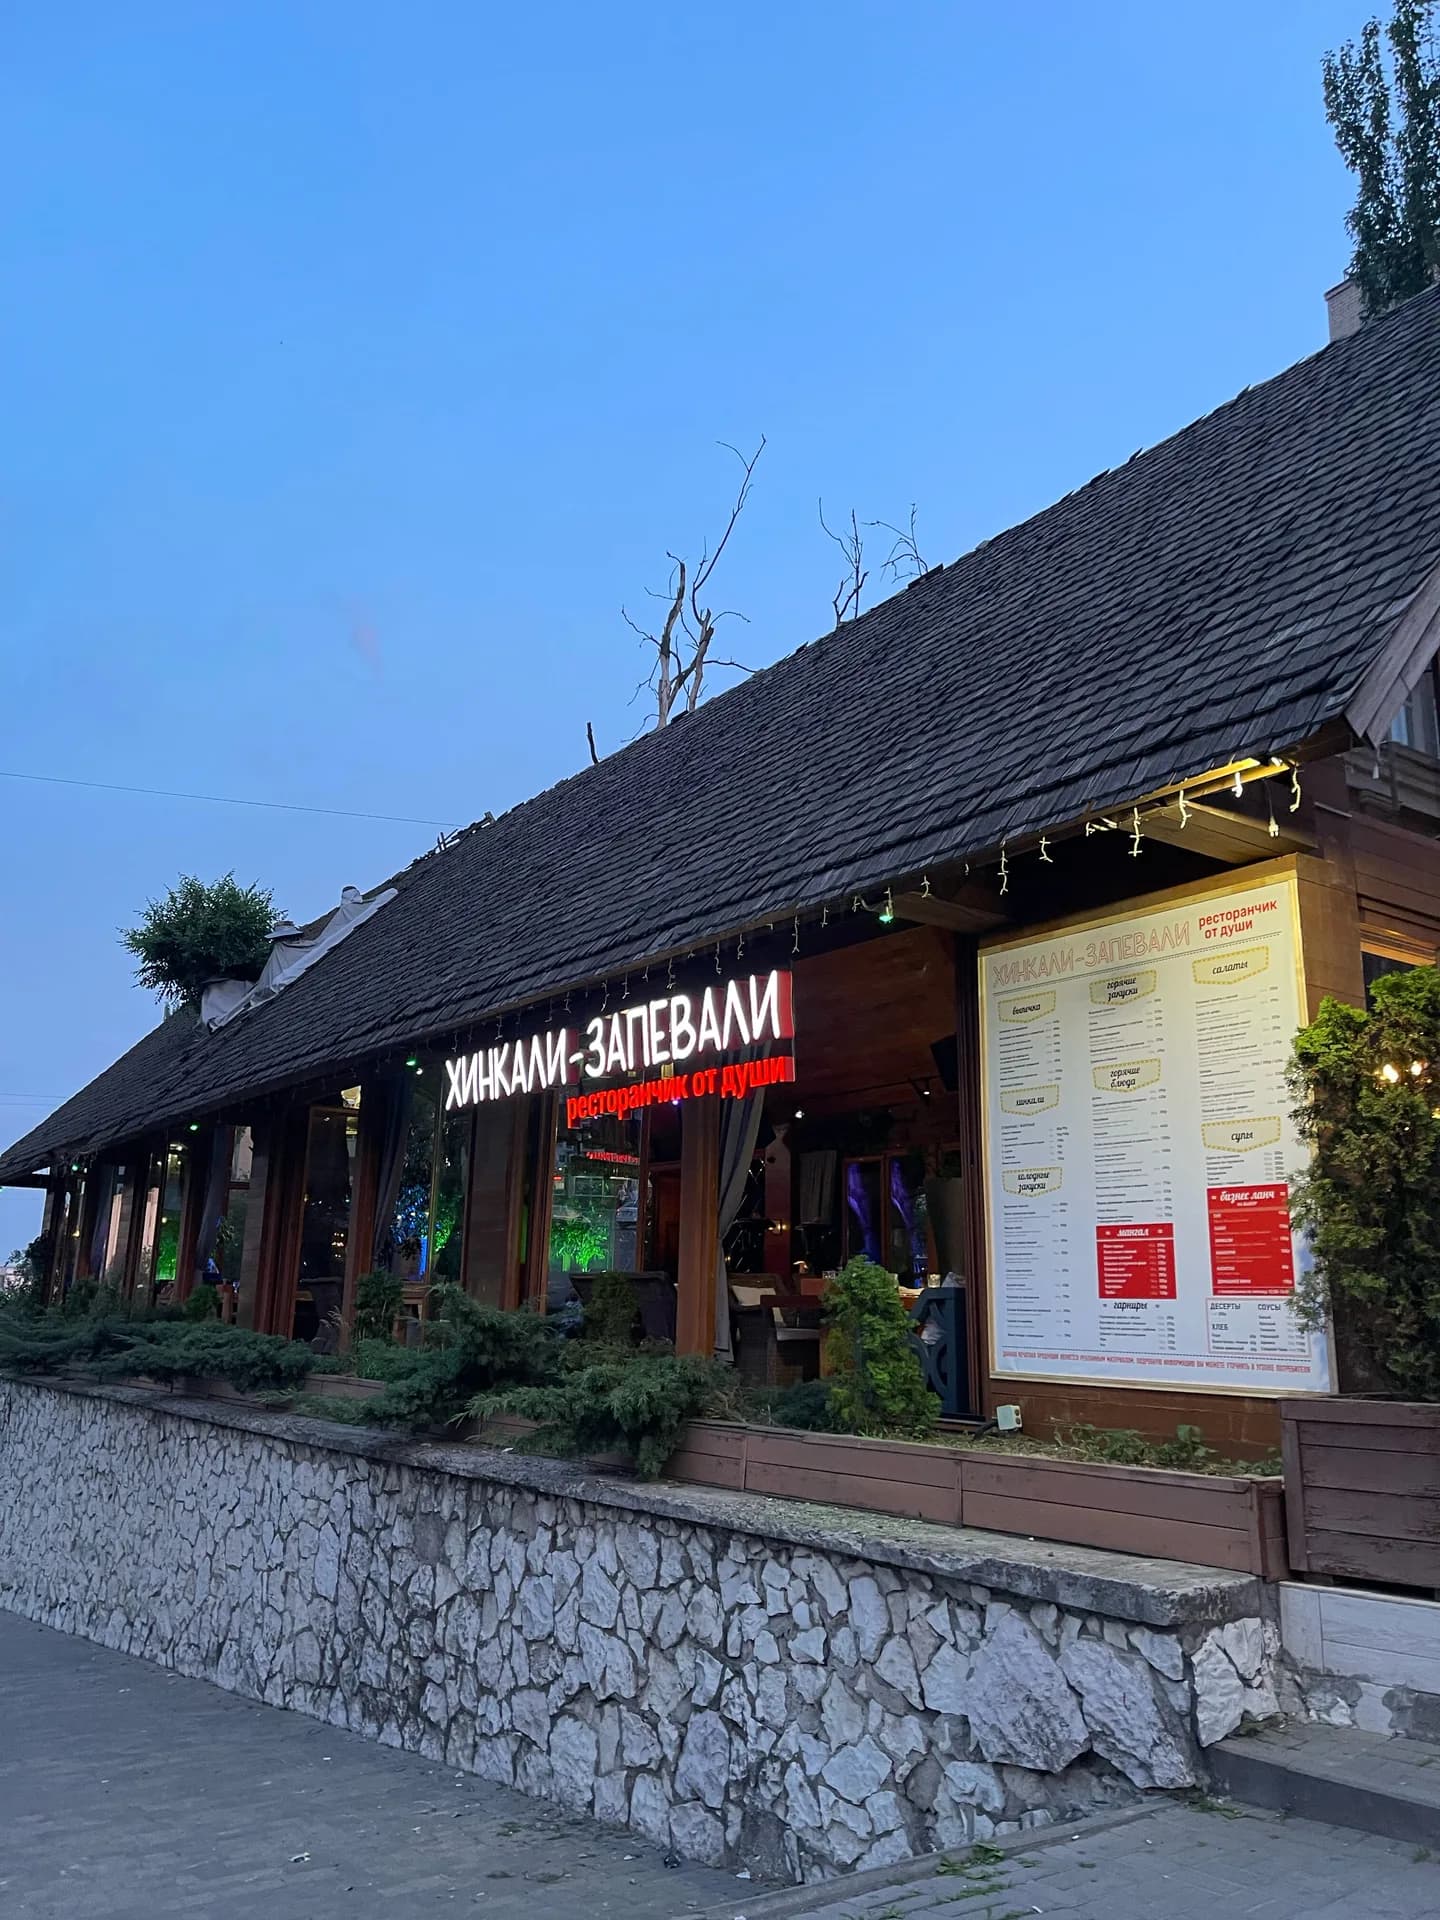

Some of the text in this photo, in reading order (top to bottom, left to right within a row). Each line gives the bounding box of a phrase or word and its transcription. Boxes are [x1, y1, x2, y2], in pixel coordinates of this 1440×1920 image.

[1198, 900, 1278, 931] ресторанчик
[1204, 920, 1254, 940] от души
[991, 920, 1191, 988] ХИНКАЛИ-ЗАПЕВАЛИ
[1212, 961, 1248, 974] салаты
[1107, 977, 1137, 990] горячие
[1108, 988, 1138, 1001] закуски
[445, 969, 783, 1111] ХИНКАЛИ-ЗАПЕВАЛИ
[1110, 1067, 1141, 1079] горячие
[1110, 1078, 1136, 1089] блюда
[566, 1056, 788, 1129] ресторанчик от души
[1231, 1131, 1254, 1143] супы
[1220, 1190, 1250, 1204] бизнес
[1250, 1190, 1275, 1200] ланч
[1113, 1301, 1148, 1313] гарниры
[1210, 1302, 1241, 1311] ДЕСЕРТЫ
[1257, 1303, 1281, 1311] СОУСЫ
